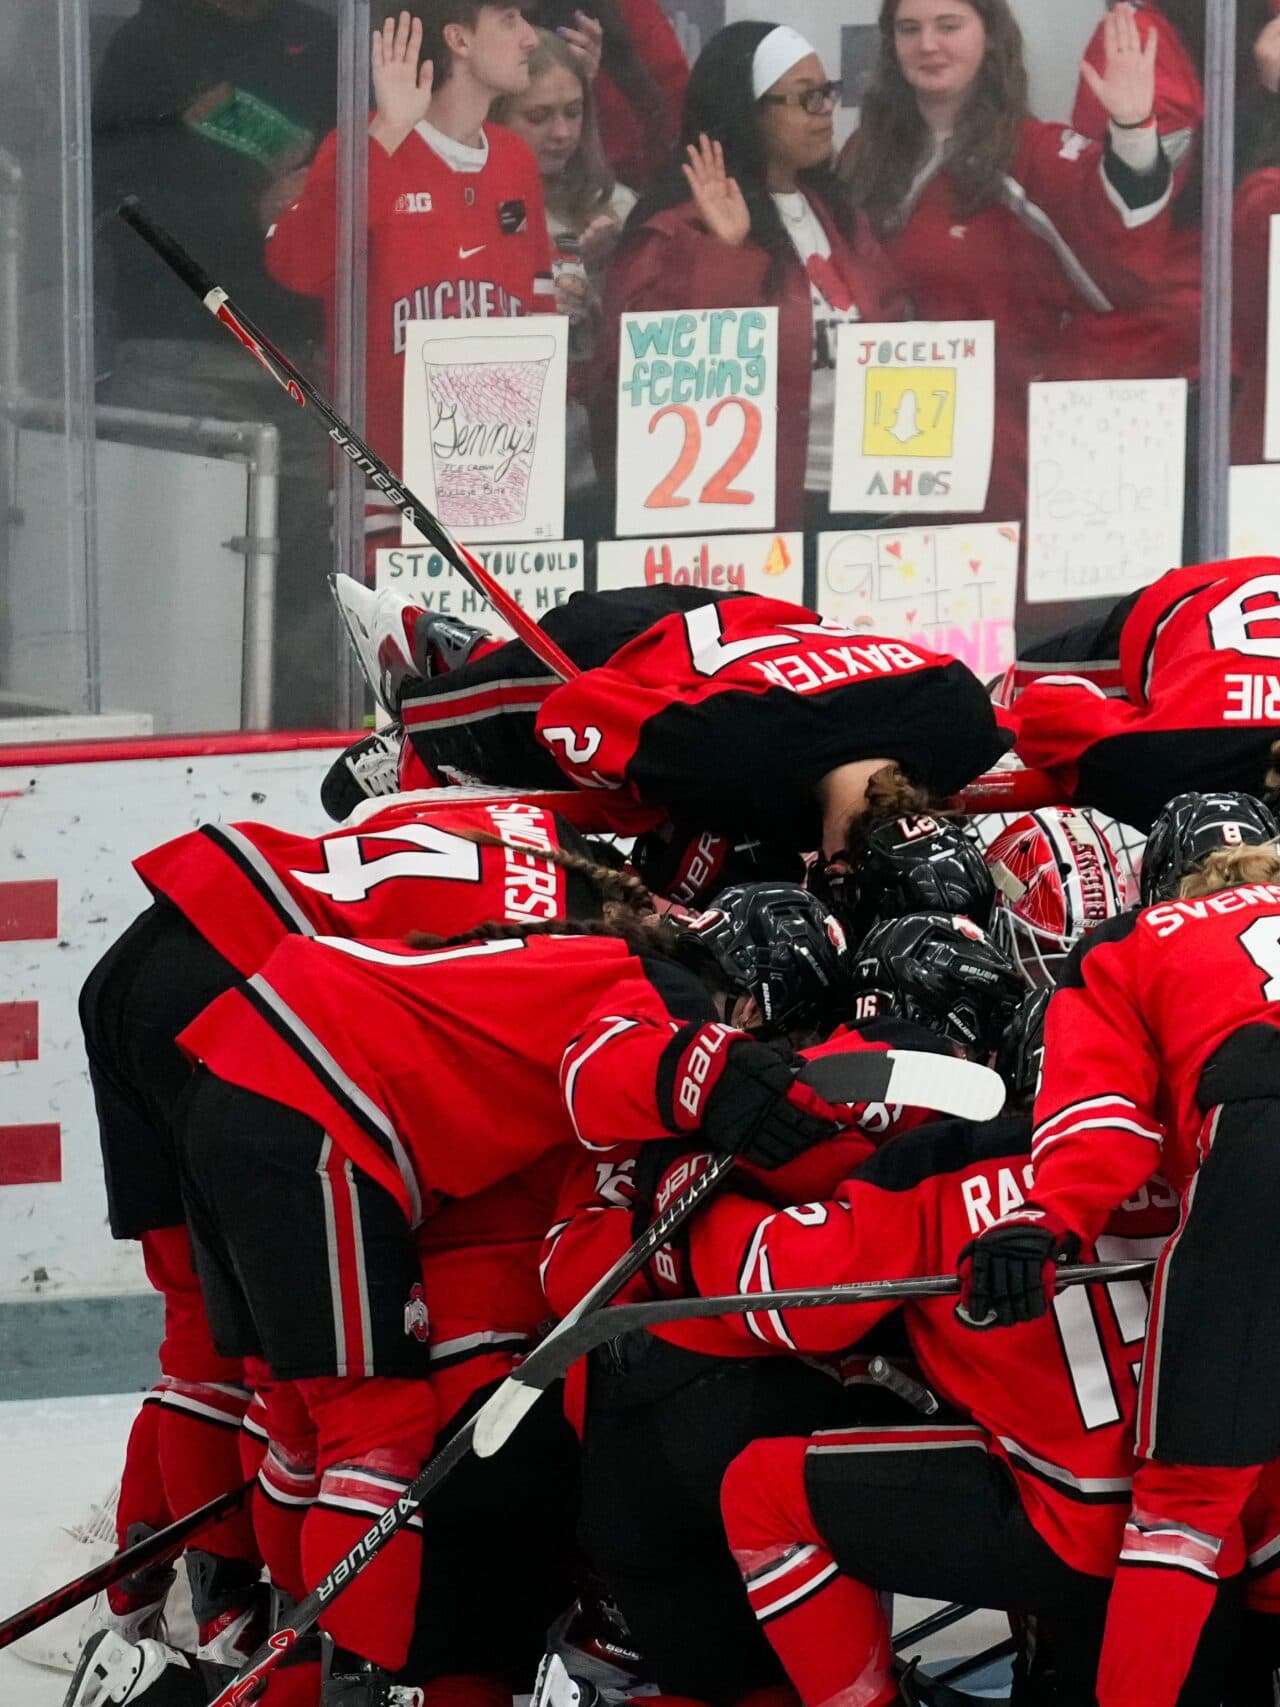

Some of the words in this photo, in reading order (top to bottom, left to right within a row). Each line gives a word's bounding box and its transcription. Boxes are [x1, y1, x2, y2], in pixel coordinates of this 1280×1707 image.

[857, 339, 976, 365] JOCELYN
[623, 355, 766, 406] feeling
[328, 427, 406, 505] BAUER
[643, 396, 763, 508] 22
[643, 543, 746, 589] Hailey
[750, 643, 925, 694] BAXTER
[1222, 823, 1241, 844] 8
[290, 823, 481, 902] 4
[959, 963, 1000, 984] BAUER
[856, 995, 878, 1019] 16
[316, 1508, 397, 1602] BAUER
